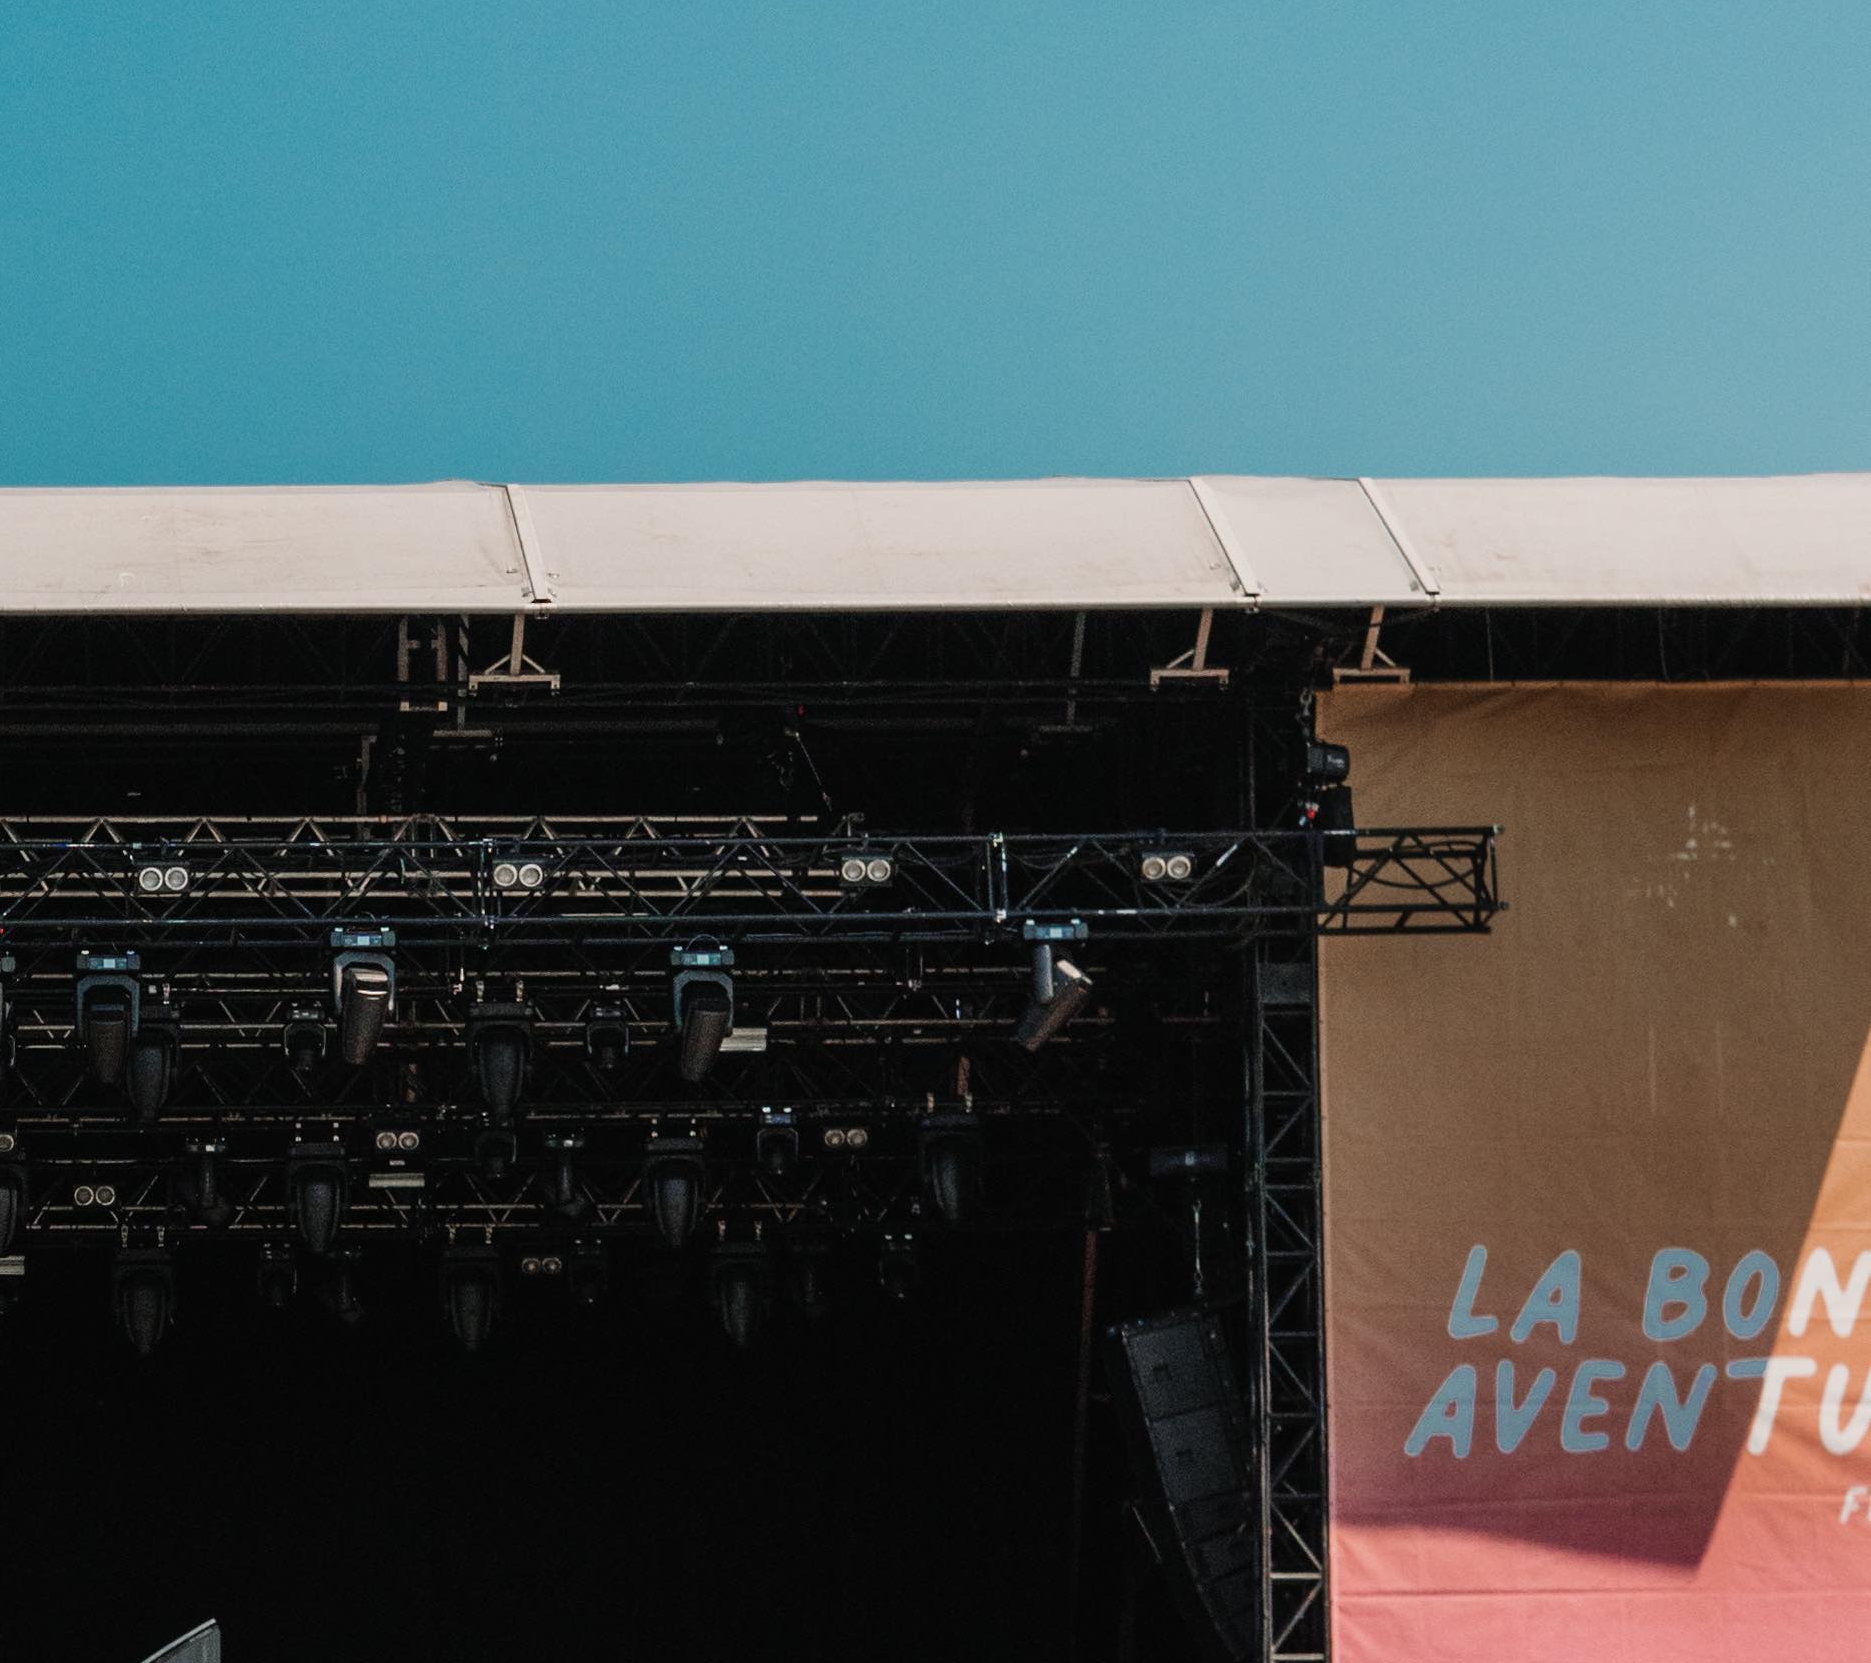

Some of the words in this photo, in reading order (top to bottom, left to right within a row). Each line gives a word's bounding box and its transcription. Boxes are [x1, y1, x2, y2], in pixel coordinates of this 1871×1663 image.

[1448, 1244, 1582, 1345] LA
[1642, 1248, 1871, 1341] BON
[1404, 1355, 1871, 1459] AVENTU
